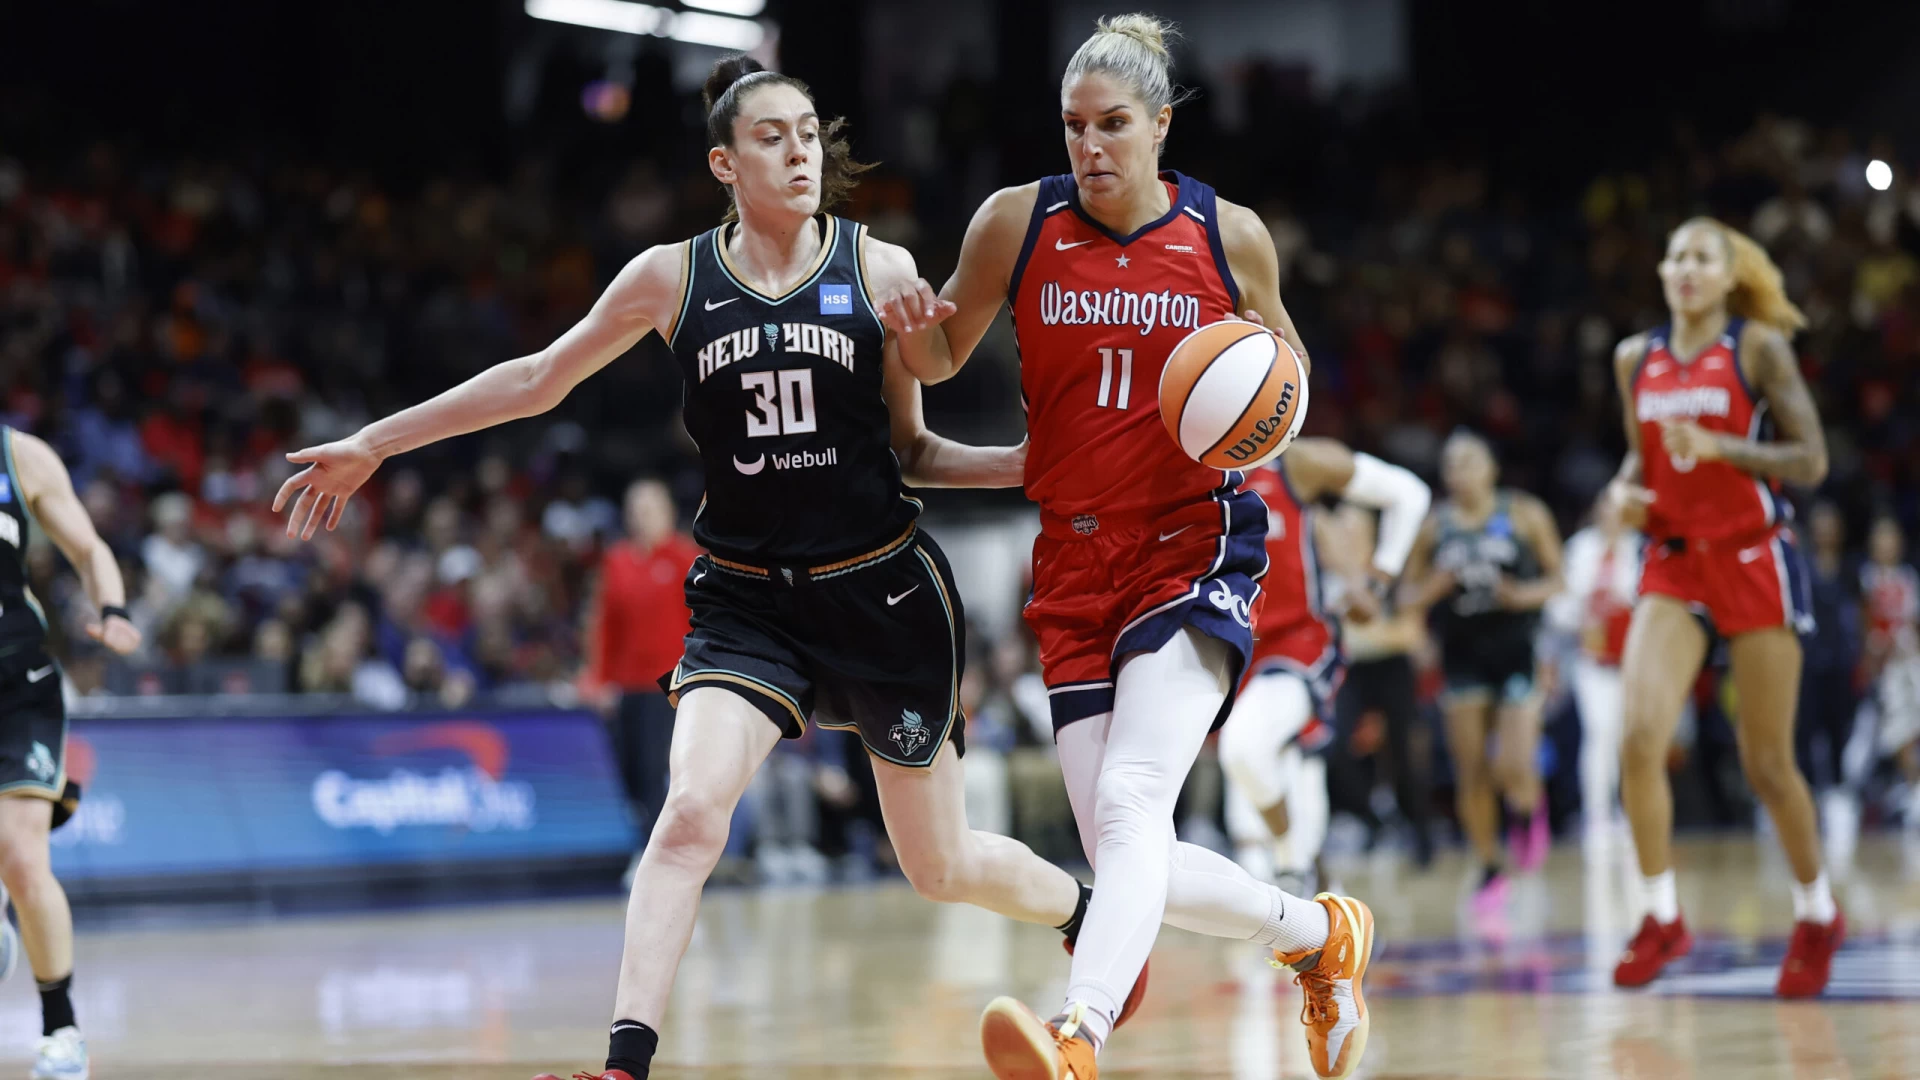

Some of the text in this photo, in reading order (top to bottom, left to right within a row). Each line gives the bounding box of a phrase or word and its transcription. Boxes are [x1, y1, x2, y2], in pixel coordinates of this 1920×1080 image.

[823, 294, 849, 305] HSS
[1040, 281, 1200, 336] Washington
[697, 323, 855, 384] NEW YORK
[1097, 348, 1133, 410] 11
[740, 368, 818, 438] 30
[1223, 381, 1295, 461] Wilson
[771, 447, 838, 470] Webull
